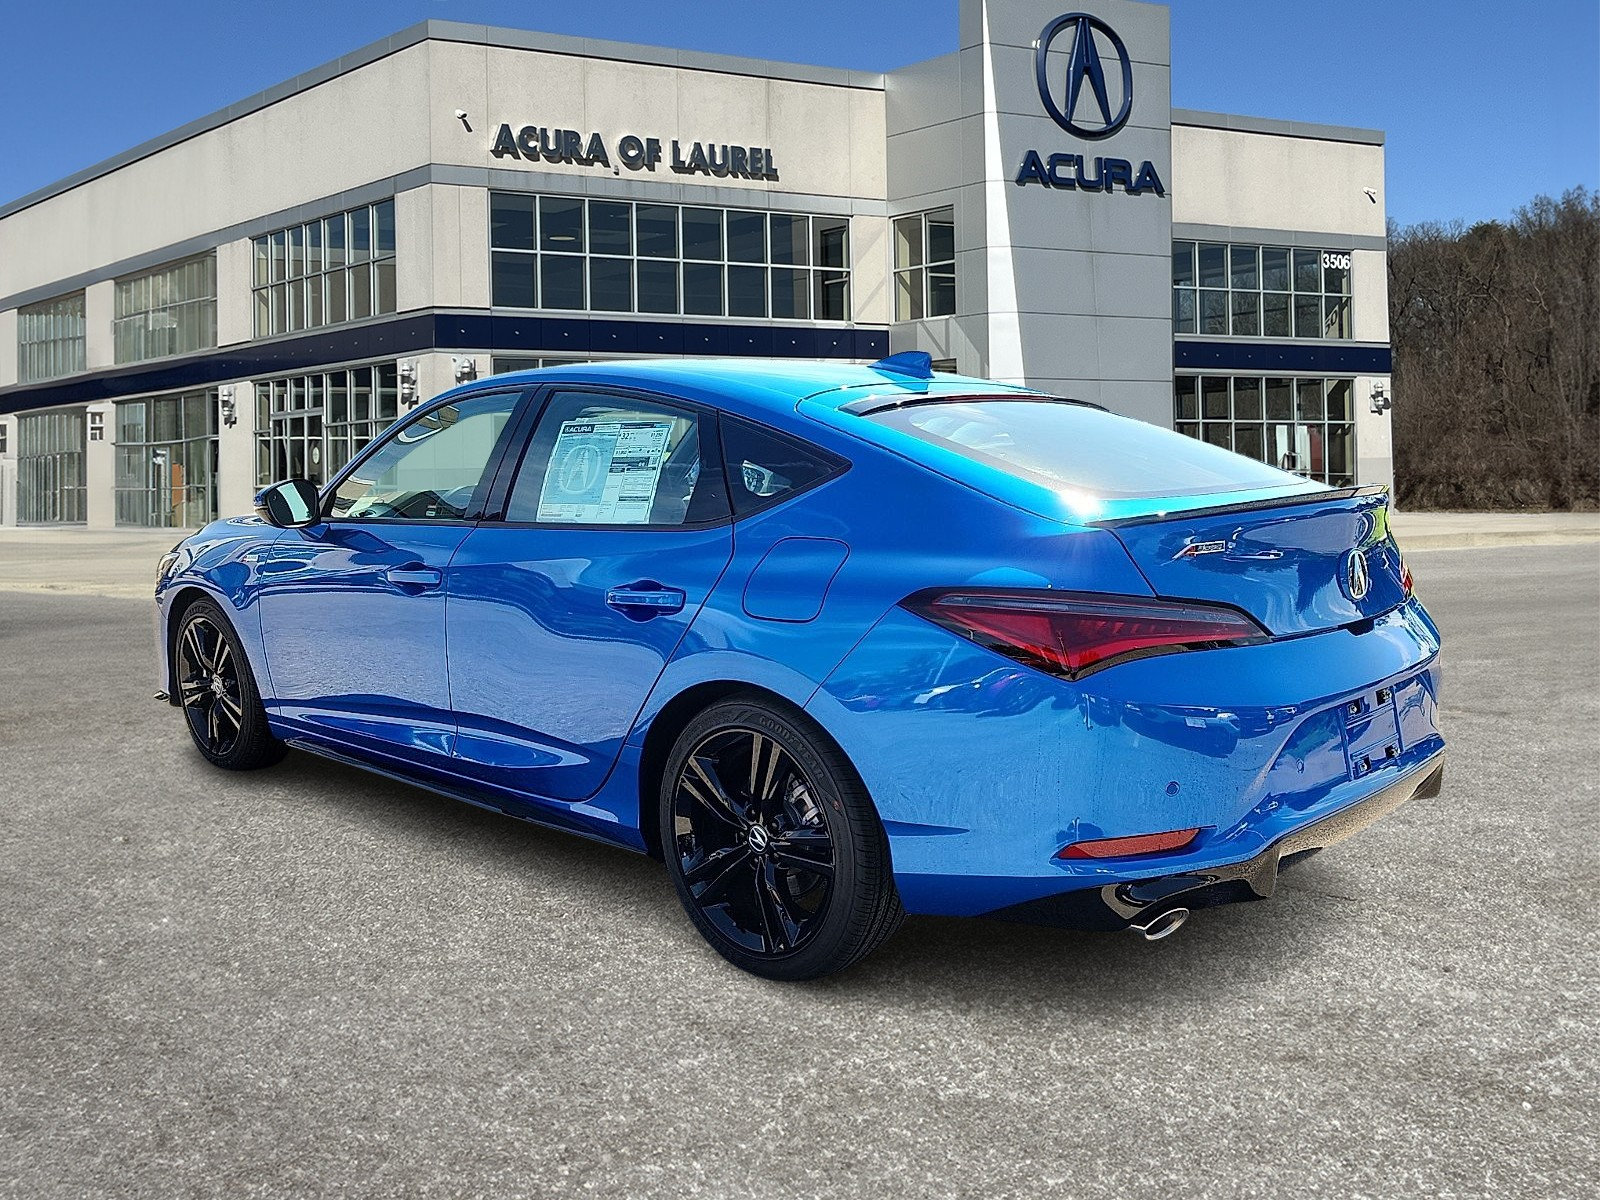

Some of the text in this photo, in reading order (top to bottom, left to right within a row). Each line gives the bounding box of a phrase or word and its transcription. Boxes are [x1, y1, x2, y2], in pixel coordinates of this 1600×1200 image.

[491, 123, 779, 181] ACURA OF LAUREL
[1015, 150, 1165, 197] ACURA
[1323, 253, 1350, 270] 3506
[621, 432, 630, 440] 32
